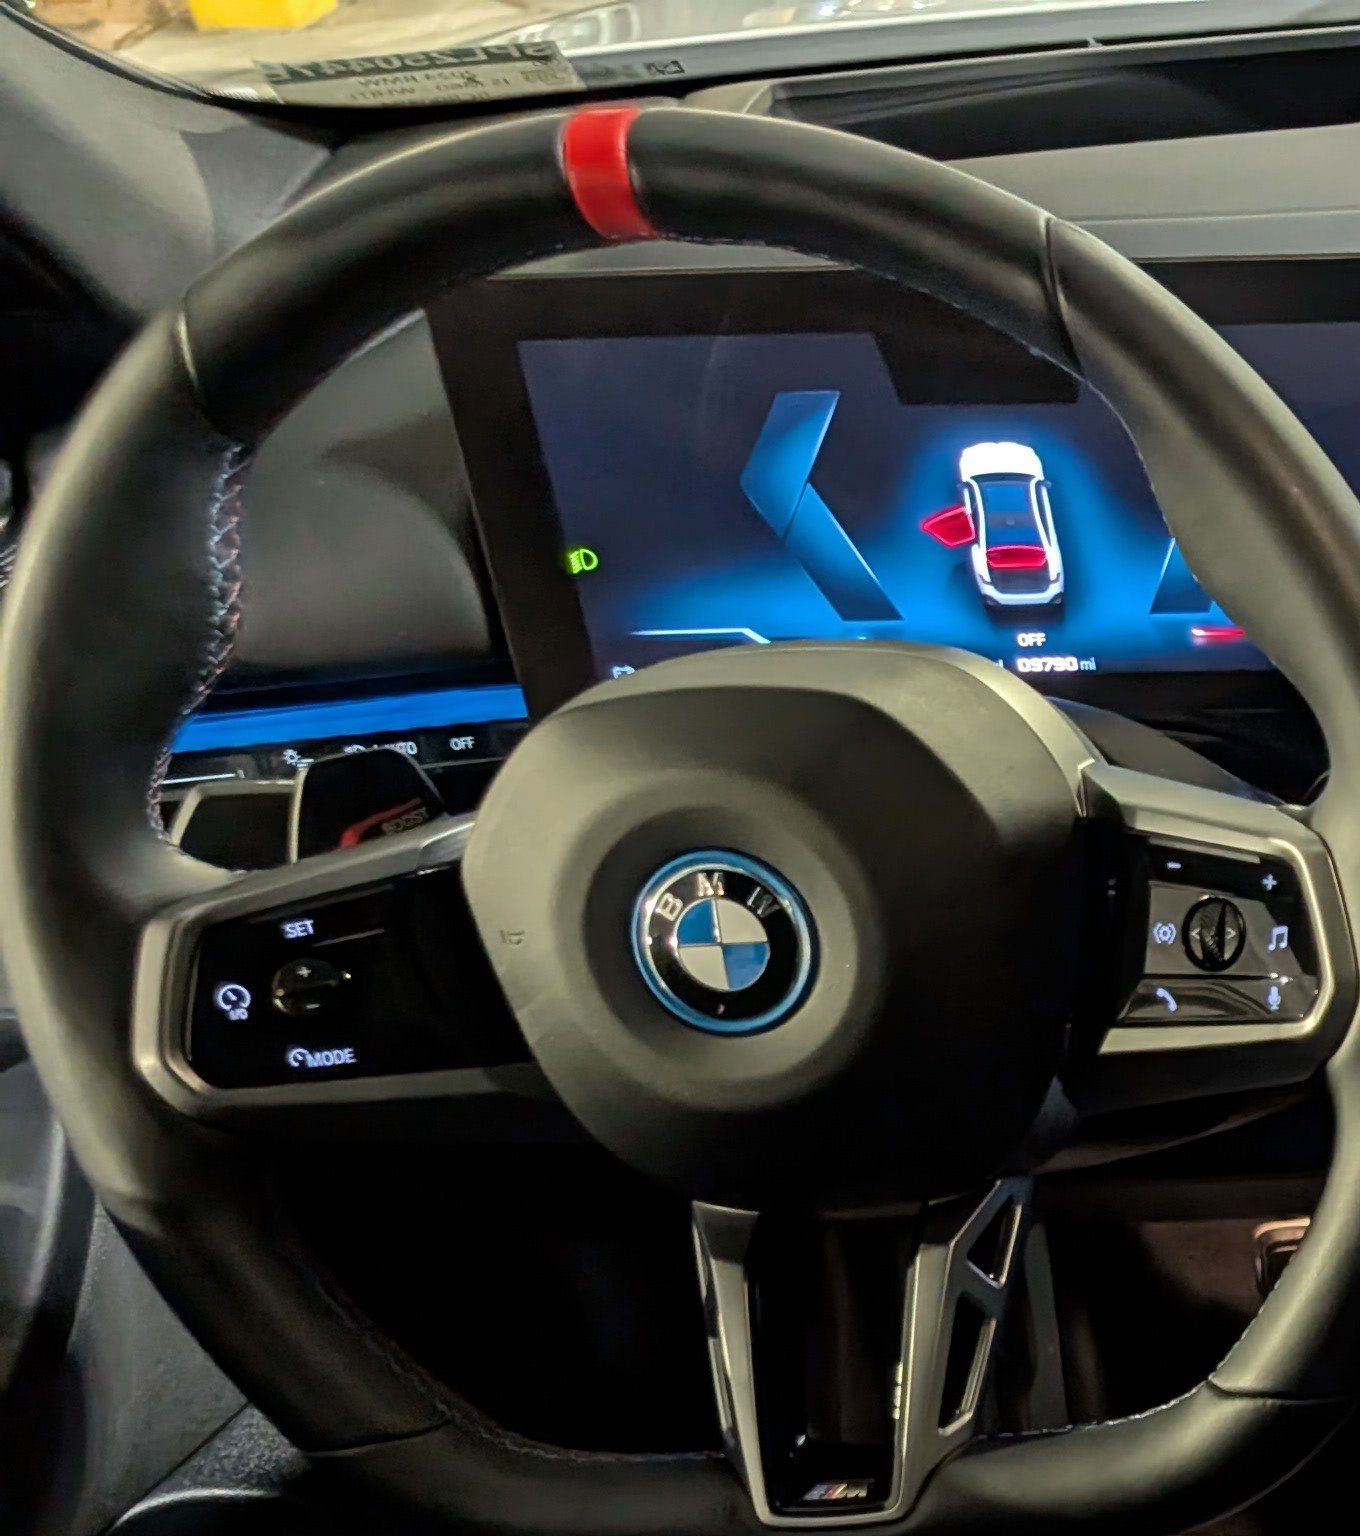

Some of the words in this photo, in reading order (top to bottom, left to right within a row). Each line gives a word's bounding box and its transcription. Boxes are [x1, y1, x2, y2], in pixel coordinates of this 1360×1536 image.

[1016, 632, 1047, 647] OFF
[1080, 657, 1097, 671] mi
[449, 735, 476, 751] OFF
[656, 871, 781, 922] BMW
[283, 918, 315, 940] SET
[305, 1047, 357, 1068] MODE
